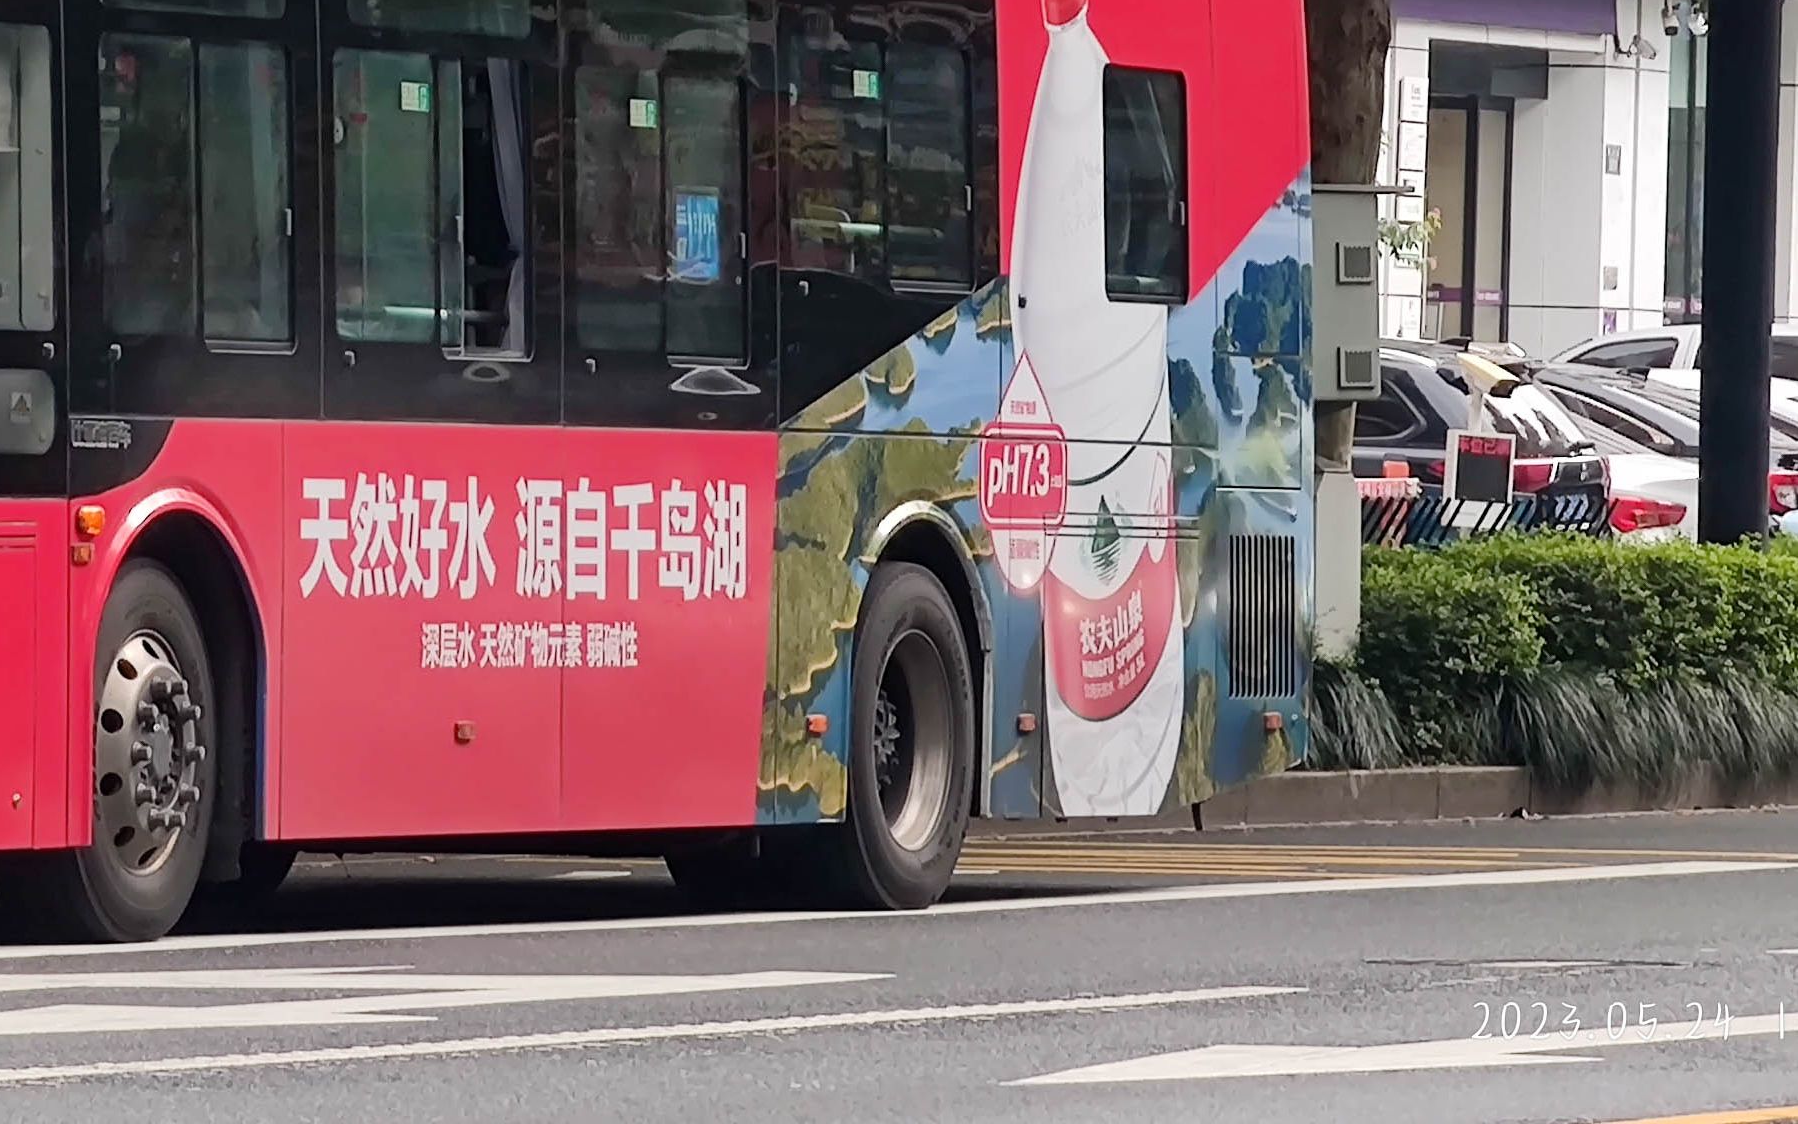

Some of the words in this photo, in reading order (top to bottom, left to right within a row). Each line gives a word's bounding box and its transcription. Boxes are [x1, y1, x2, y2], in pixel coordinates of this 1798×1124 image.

[299, 472, 496, 600] 天然好水
[515, 476, 748, 601] 源自千岛湖
[421, 621, 475, 669] 深层水
[479, 621, 582, 669] 天然矿物元素
[586, 621, 638, 668] 弱碱性
[1079, 589, 1144, 655] 农夫山泉
